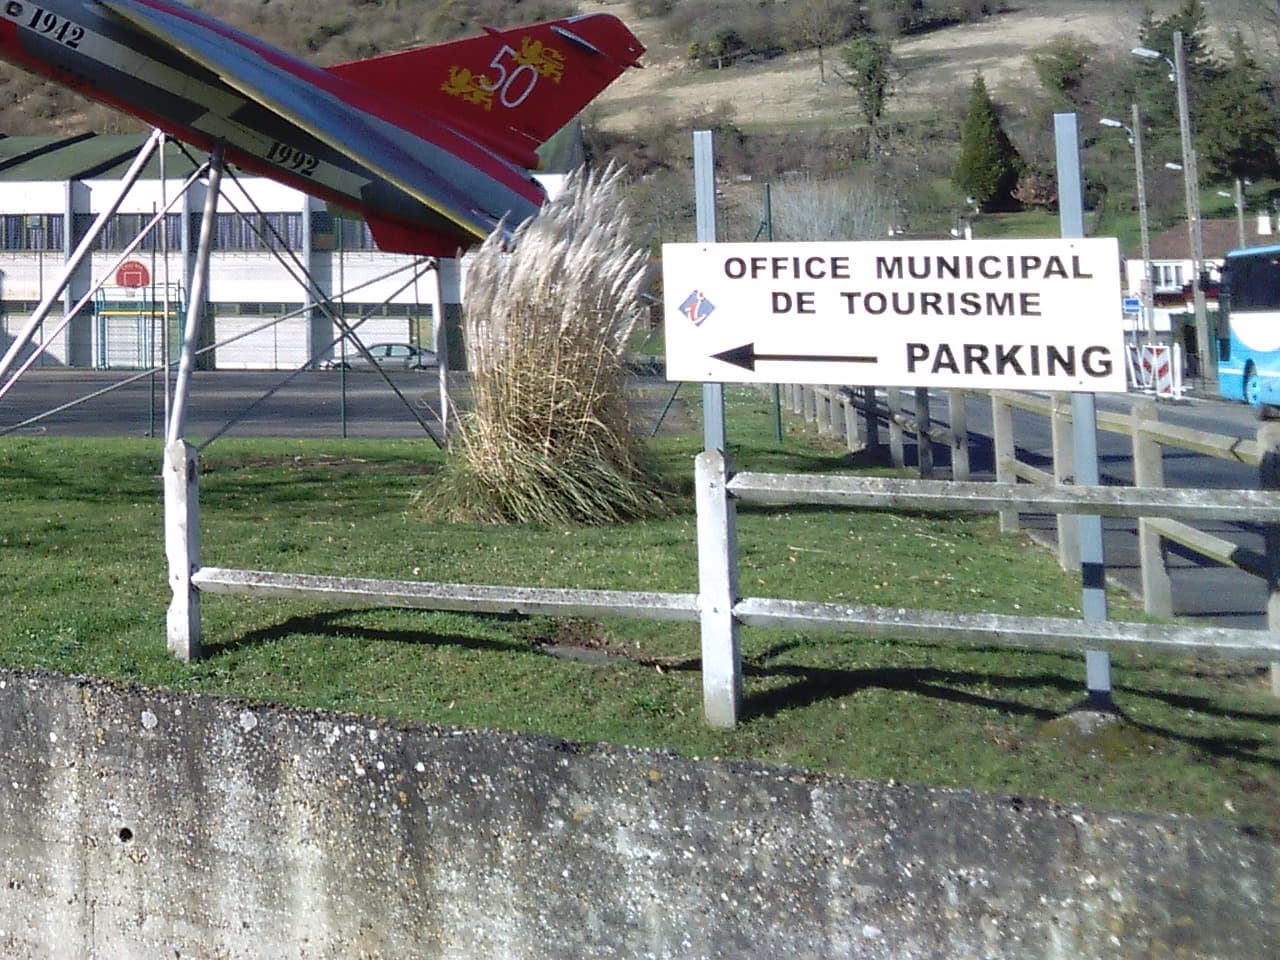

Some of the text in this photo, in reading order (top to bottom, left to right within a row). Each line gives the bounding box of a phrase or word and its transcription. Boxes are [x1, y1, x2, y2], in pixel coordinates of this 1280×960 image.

[28, 7, 85, 49] 1942
[479, 45, 539, 109] 50
[266, 142, 320, 177] 1992
[723, 255, 1094, 280] OFFICE MUNICIPAL
[770, 291, 1043, 316] DE TOURISME
[905, 342, 1114, 378] PARKING
